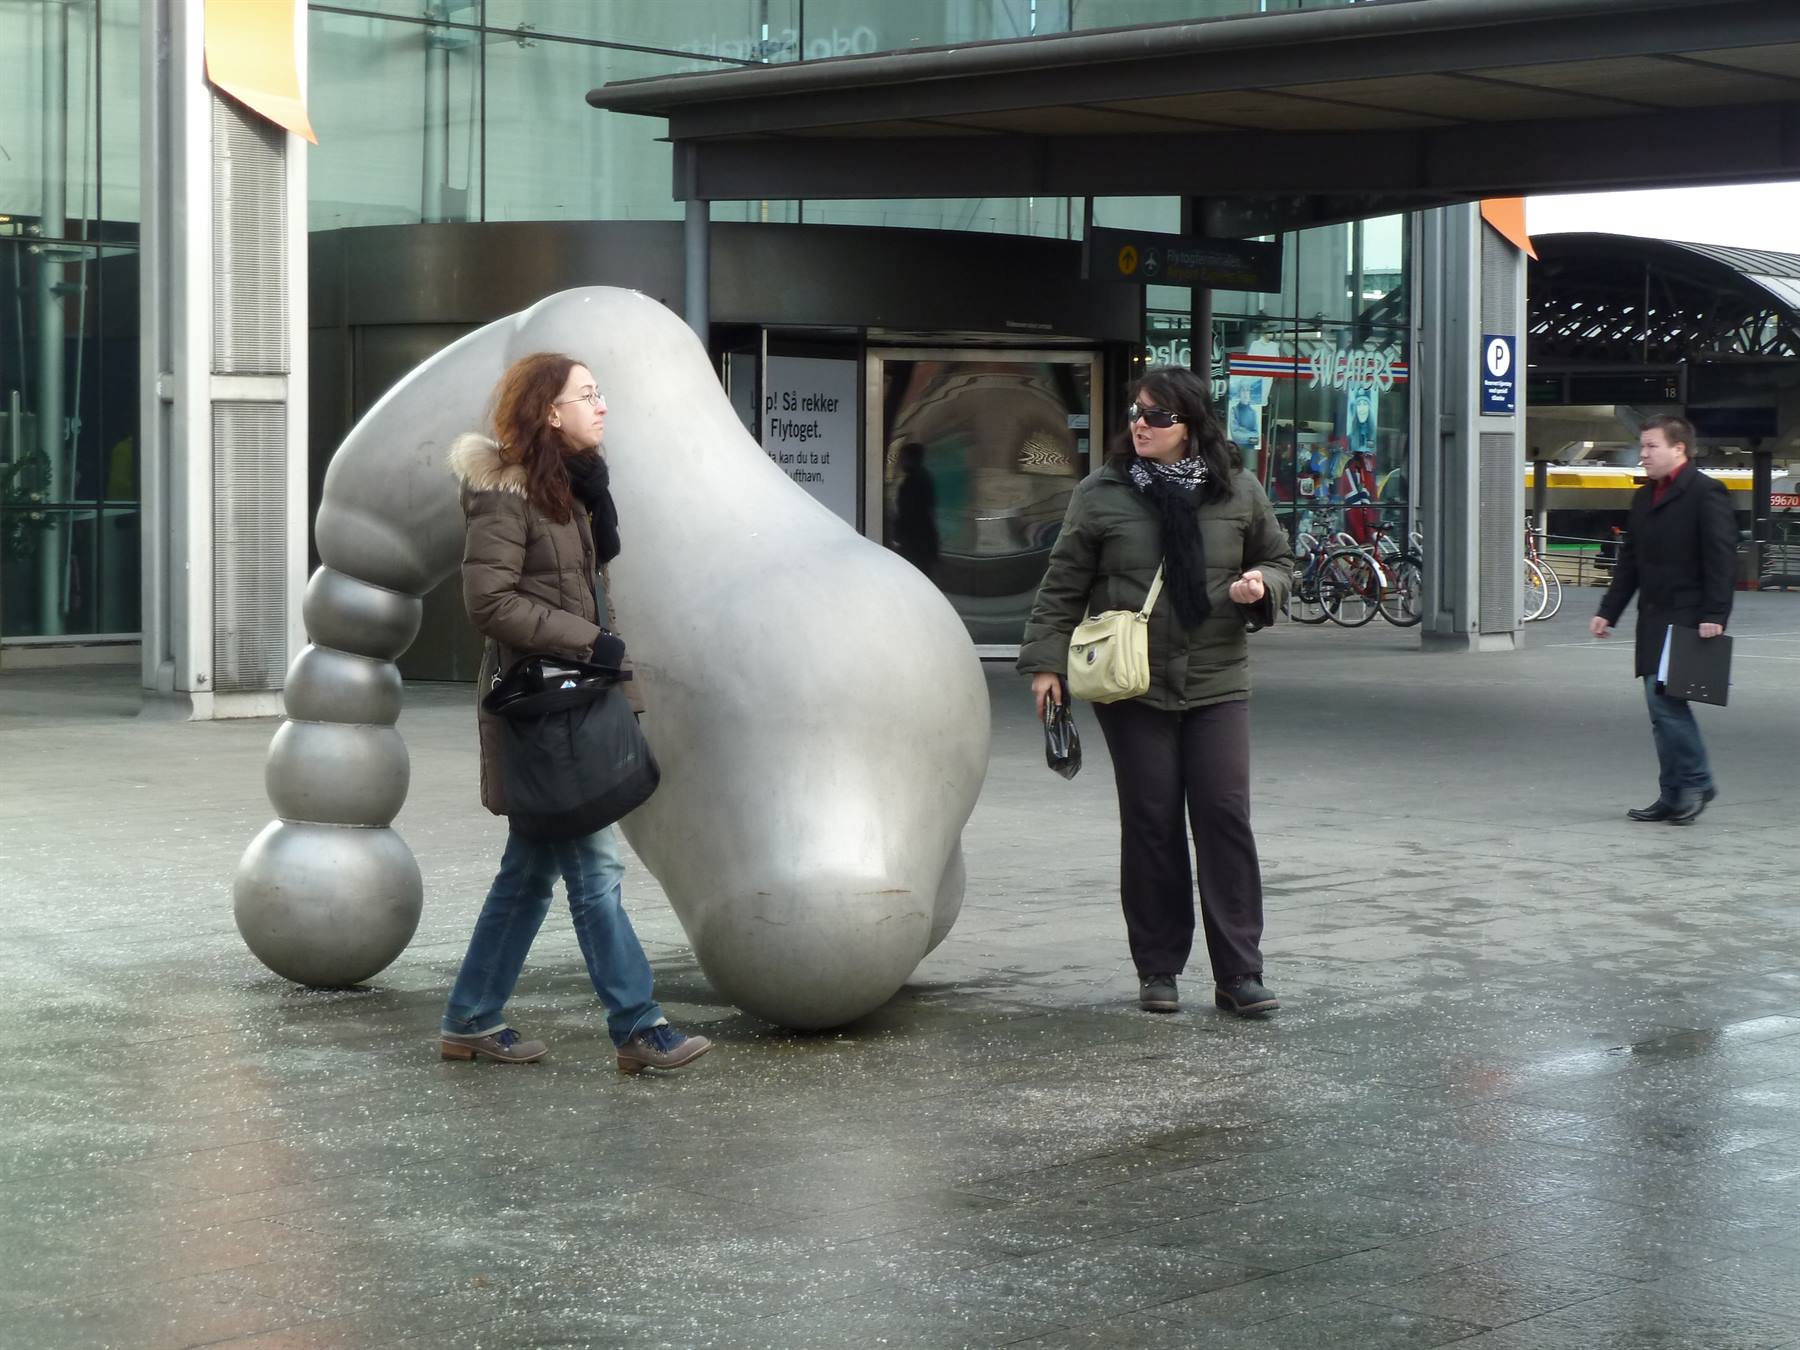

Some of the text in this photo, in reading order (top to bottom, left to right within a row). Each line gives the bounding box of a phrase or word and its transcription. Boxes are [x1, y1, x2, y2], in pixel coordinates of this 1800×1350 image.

[1495, 345, 1504, 370] P
[1309, 348, 1395, 393] SWEATERS
[782, 390, 798, 411] Så
[801, 391, 839, 413] rekker
[1664, 387, 1677, 399] 18
[770, 418, 822, 442] Flytoget.
[779, 450, 795, 464] kan
[796, 451, 807, 464] du
[810, 452, 818, 465] ta
[821, 452, 830, 465] ut
[784, 468, 825, 484] ufthavn,
